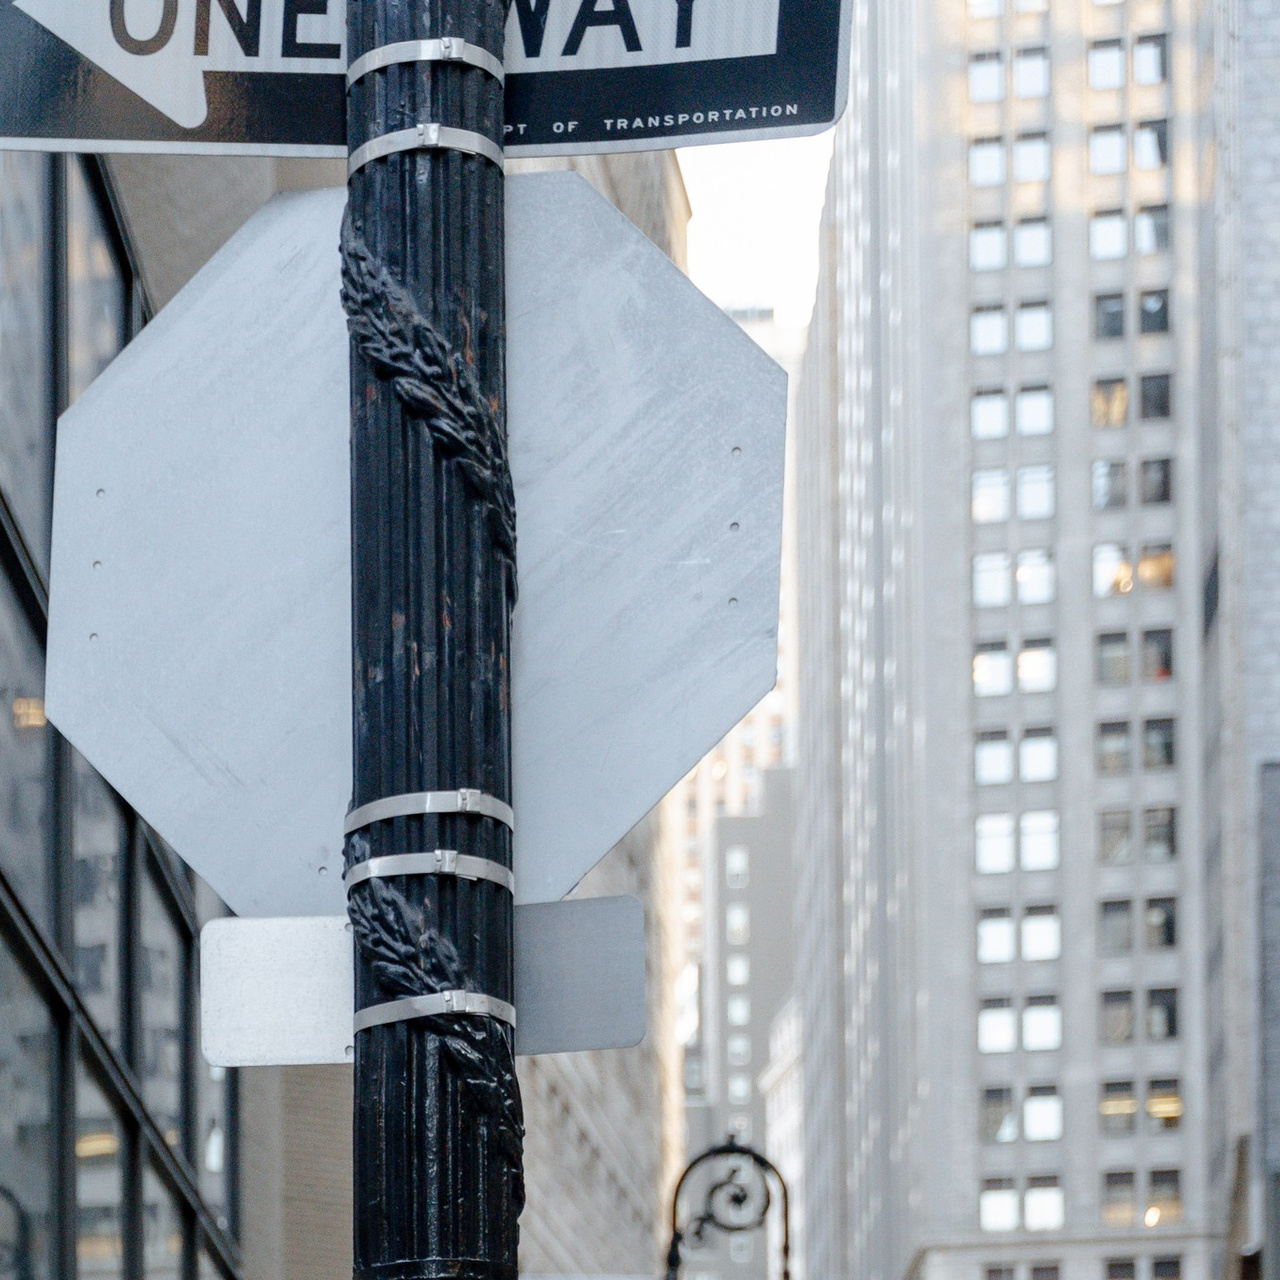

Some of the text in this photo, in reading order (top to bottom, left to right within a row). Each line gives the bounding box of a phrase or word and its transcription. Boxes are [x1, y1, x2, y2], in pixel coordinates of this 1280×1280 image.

[109, 0, 694, 59] ONE AY
[552, 121, 579, 133] OF
[604, 103, 798, 131] TRANSPORTATION
